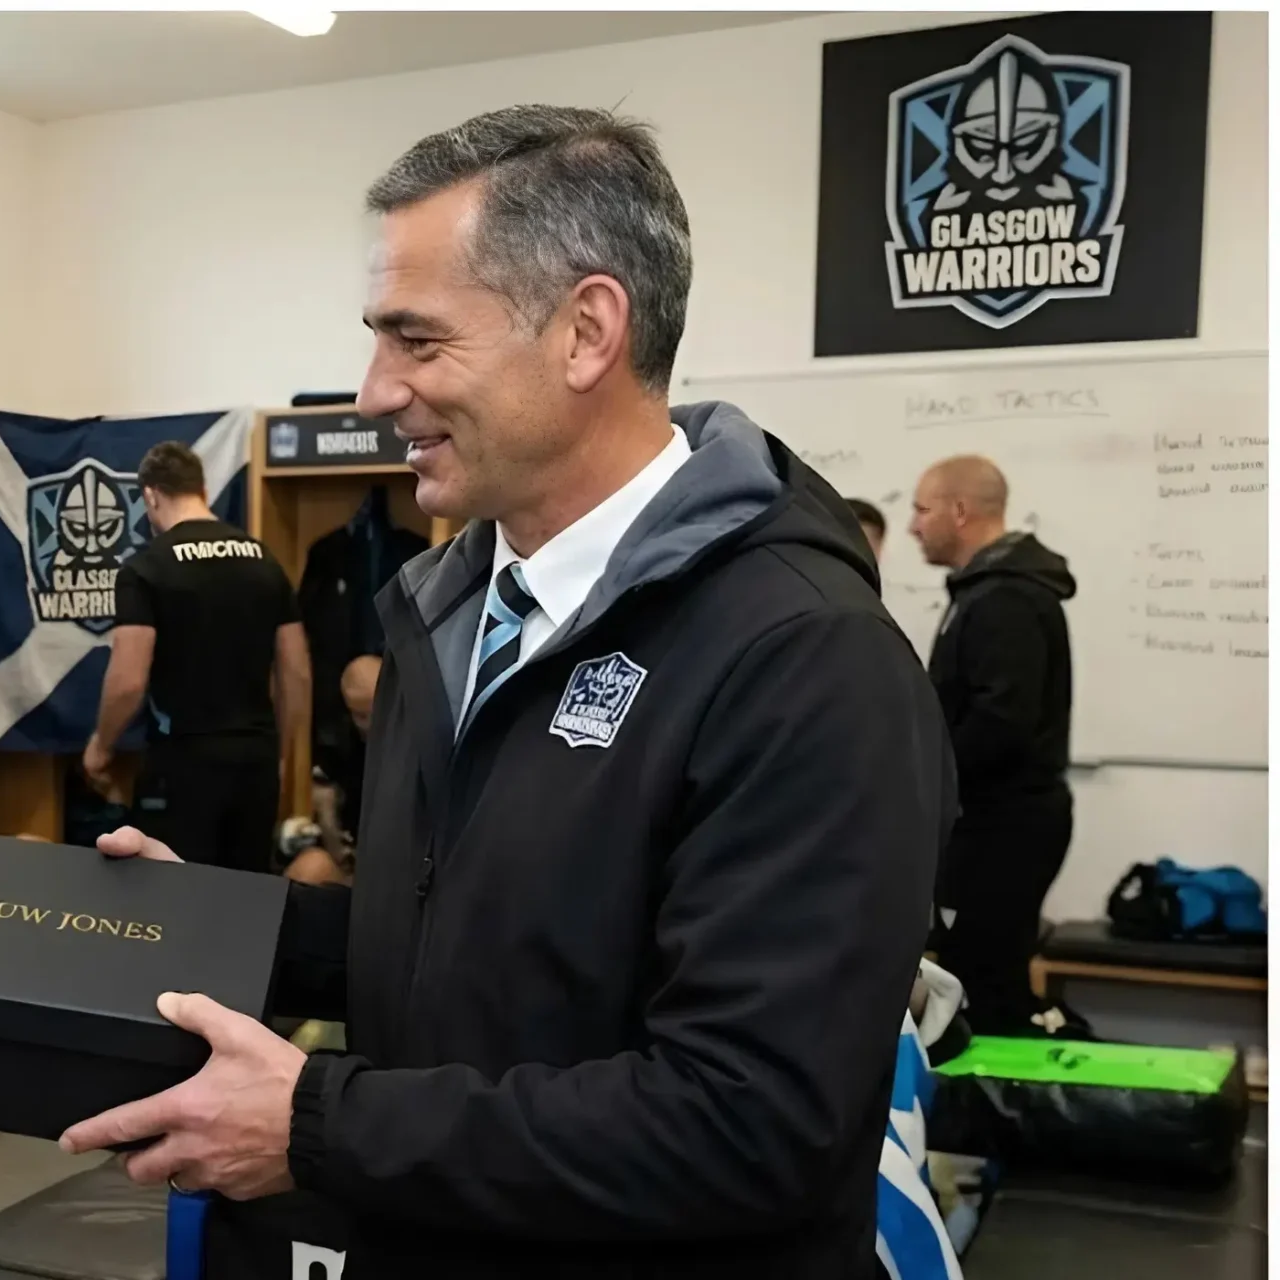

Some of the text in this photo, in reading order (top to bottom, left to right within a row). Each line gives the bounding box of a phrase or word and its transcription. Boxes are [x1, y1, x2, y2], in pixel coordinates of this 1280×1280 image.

[930, 204, 1076, 248] GLASGOW
[903, 240, 1101, 293] WARRIORS
[56, 911, 163, 942] JONES
